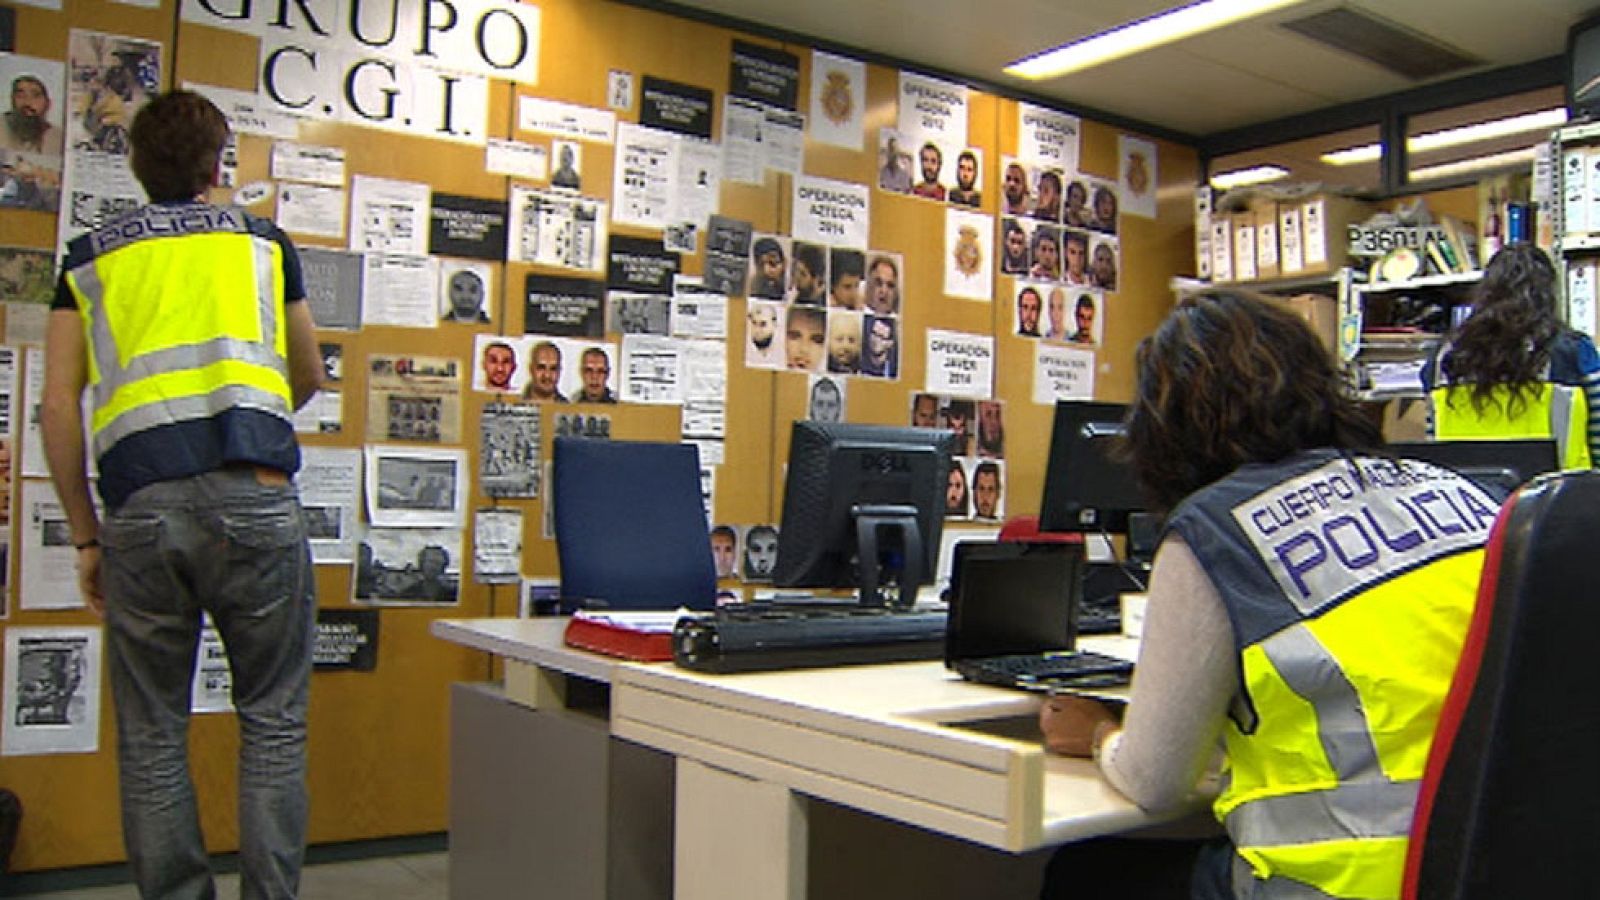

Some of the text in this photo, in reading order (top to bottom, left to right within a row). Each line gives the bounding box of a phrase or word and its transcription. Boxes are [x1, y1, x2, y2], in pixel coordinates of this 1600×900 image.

[263, 46, 473, 135] C.G.I.
[98, 209, 240, 249] POLICIA
[810, 204, 855, 222] AZTECA
[1252, 475, 1354, 536] CUERPO
[1274, 485, 1498, 599] POLICIA
